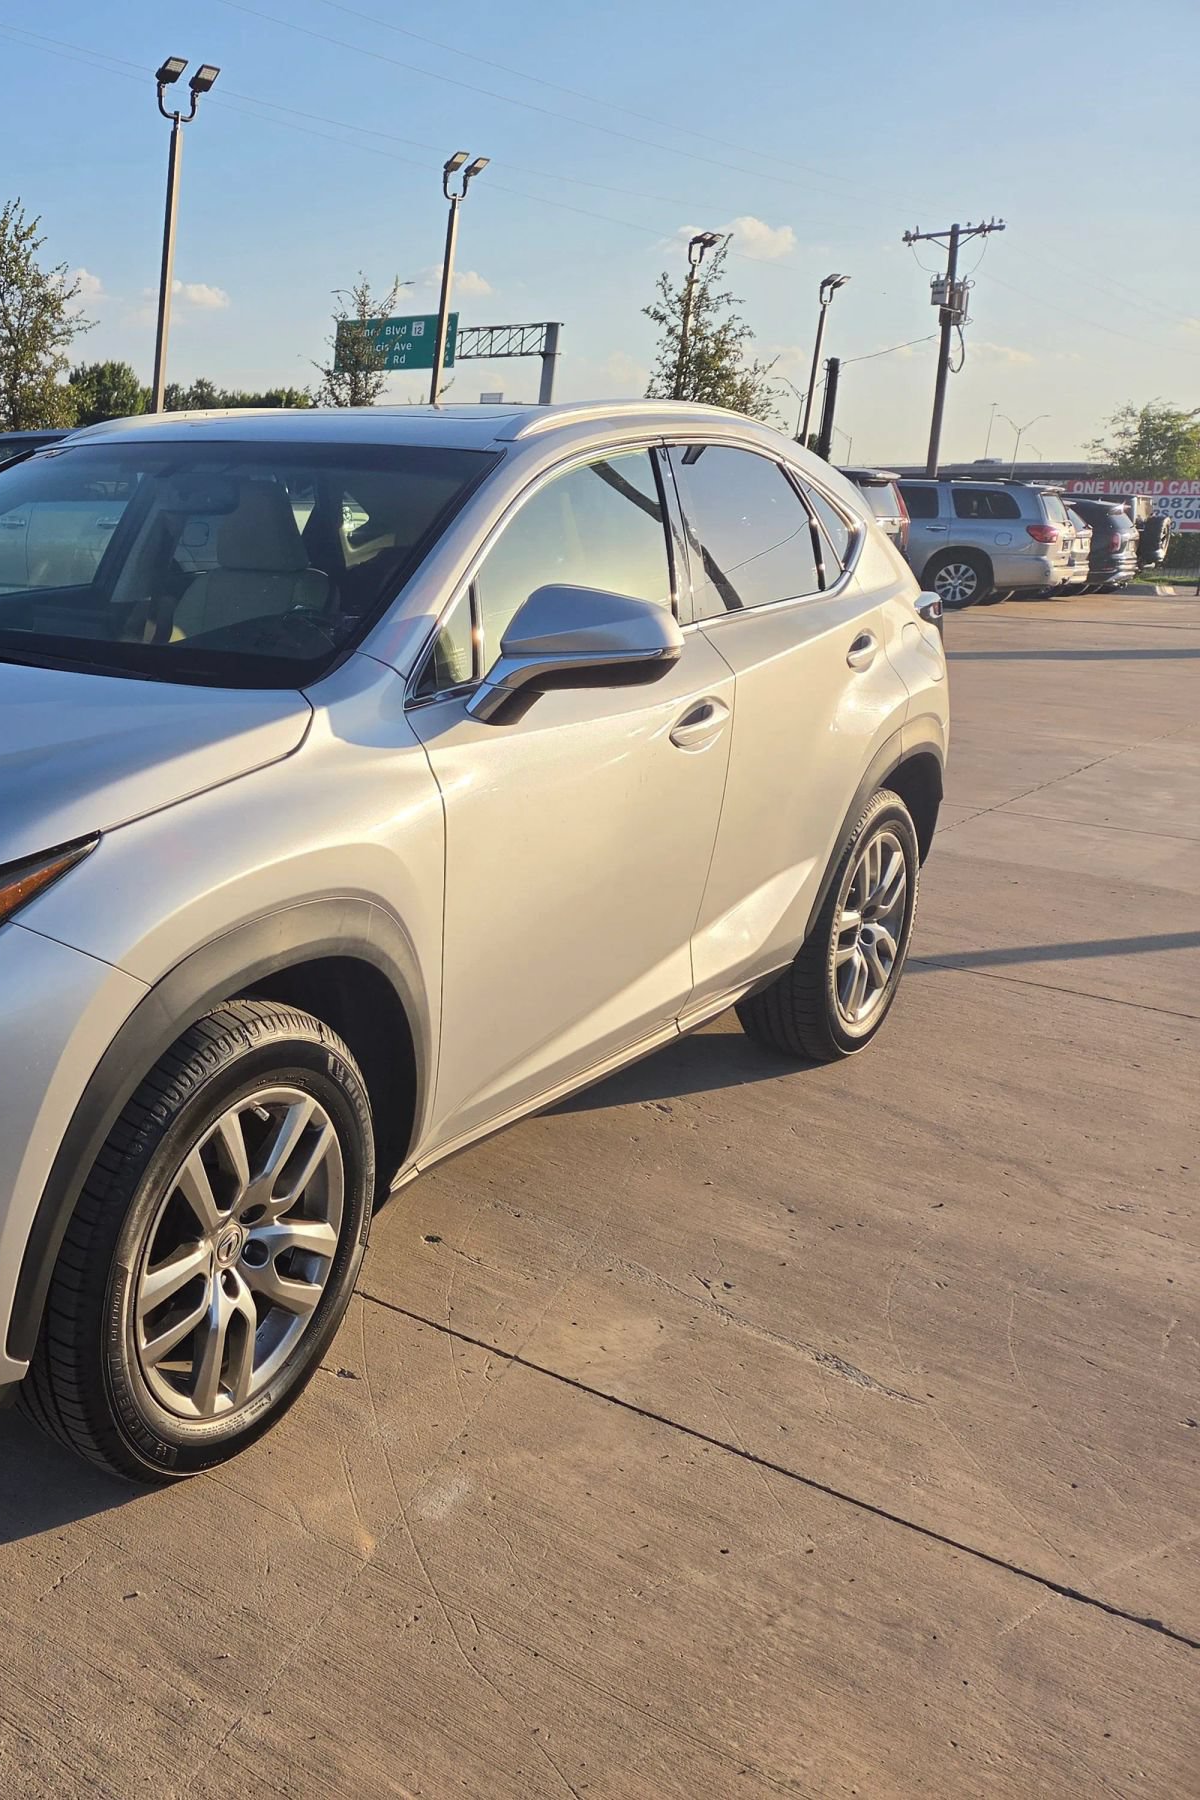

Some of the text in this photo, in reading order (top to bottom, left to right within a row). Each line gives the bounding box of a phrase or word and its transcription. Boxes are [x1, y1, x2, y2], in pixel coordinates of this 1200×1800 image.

[385, 326, 407, 336] Blvd
[414, 326, 422, 335] 12
[393, 342, 412, 351] Ave
[393, 354, 406, 364] Rd
[1073, 481, 1105, 494] ONE
[1109, 481, 1164, 495] WORLD
